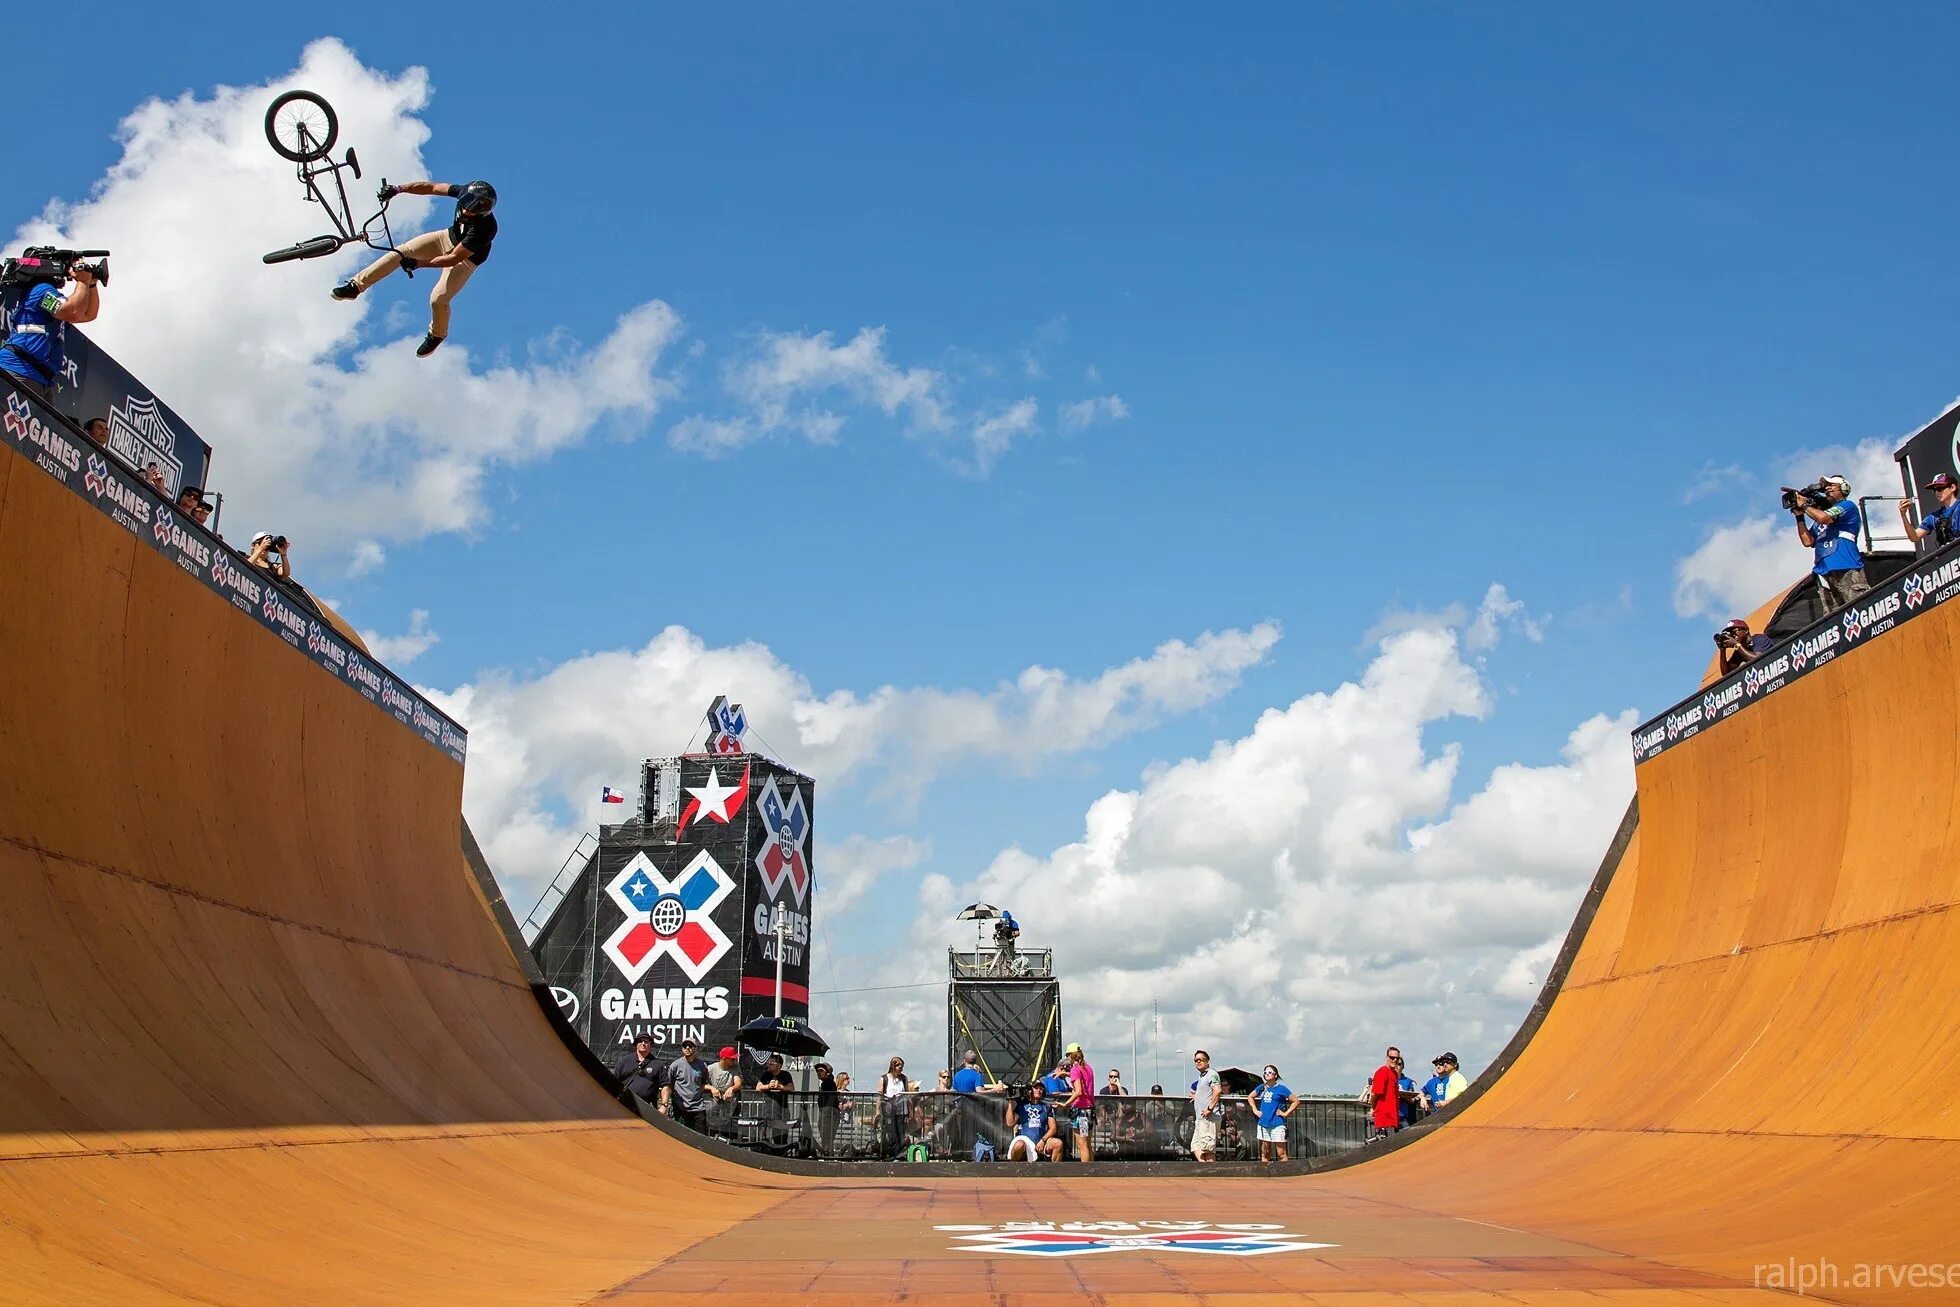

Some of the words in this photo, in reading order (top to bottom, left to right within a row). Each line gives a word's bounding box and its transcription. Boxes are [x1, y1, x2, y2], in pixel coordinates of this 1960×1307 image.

[29, 418, 80, 472] GAMES
[36, 453, 67, 482] AUSTIN
[106, 476, 151, 523] GAMES
[112, 508, 139, 533] AUSTIN
[172, 525, 210, 567] GAMES
[177, 554, 200, 577] AUSTIN
[1923, 556, 1960, 595] GAME
[227, 567, 260, 604] GAMES
[1935, 581, 1960, 604] AUSTIN
[232, 594, 252, 614] AUSTIN
[1860, 592, 1900, 629] GAMES
[277, 604, 306, 637] GAMES
[1871, 618, 1895, 637] AUSTIN
[281, 629, 298, 647] AUSTIN
[320, 636, 345, 666] GAMES
[1805, 625, 1840, 659] GAMES
[1757, 655, 1789, 685] GAMES
[1815, 649, 1835, 667] AUSTIN
[358, 664, 381, 692] GAMES
[1766, 677, 1785, 694] AUSTIN
[392, 690, 412, 715] GAMES
[1715, 682, 1743, 710] GAMES
[1723, 702, 1740, 718] AUSTIN
[422, 712, 440, 736] GAMES
[1677, 705, 1702, 731] GAMES
[1643, 726, 1665, 750] GAMES
[600, 986, 730, 1020] GAMES
